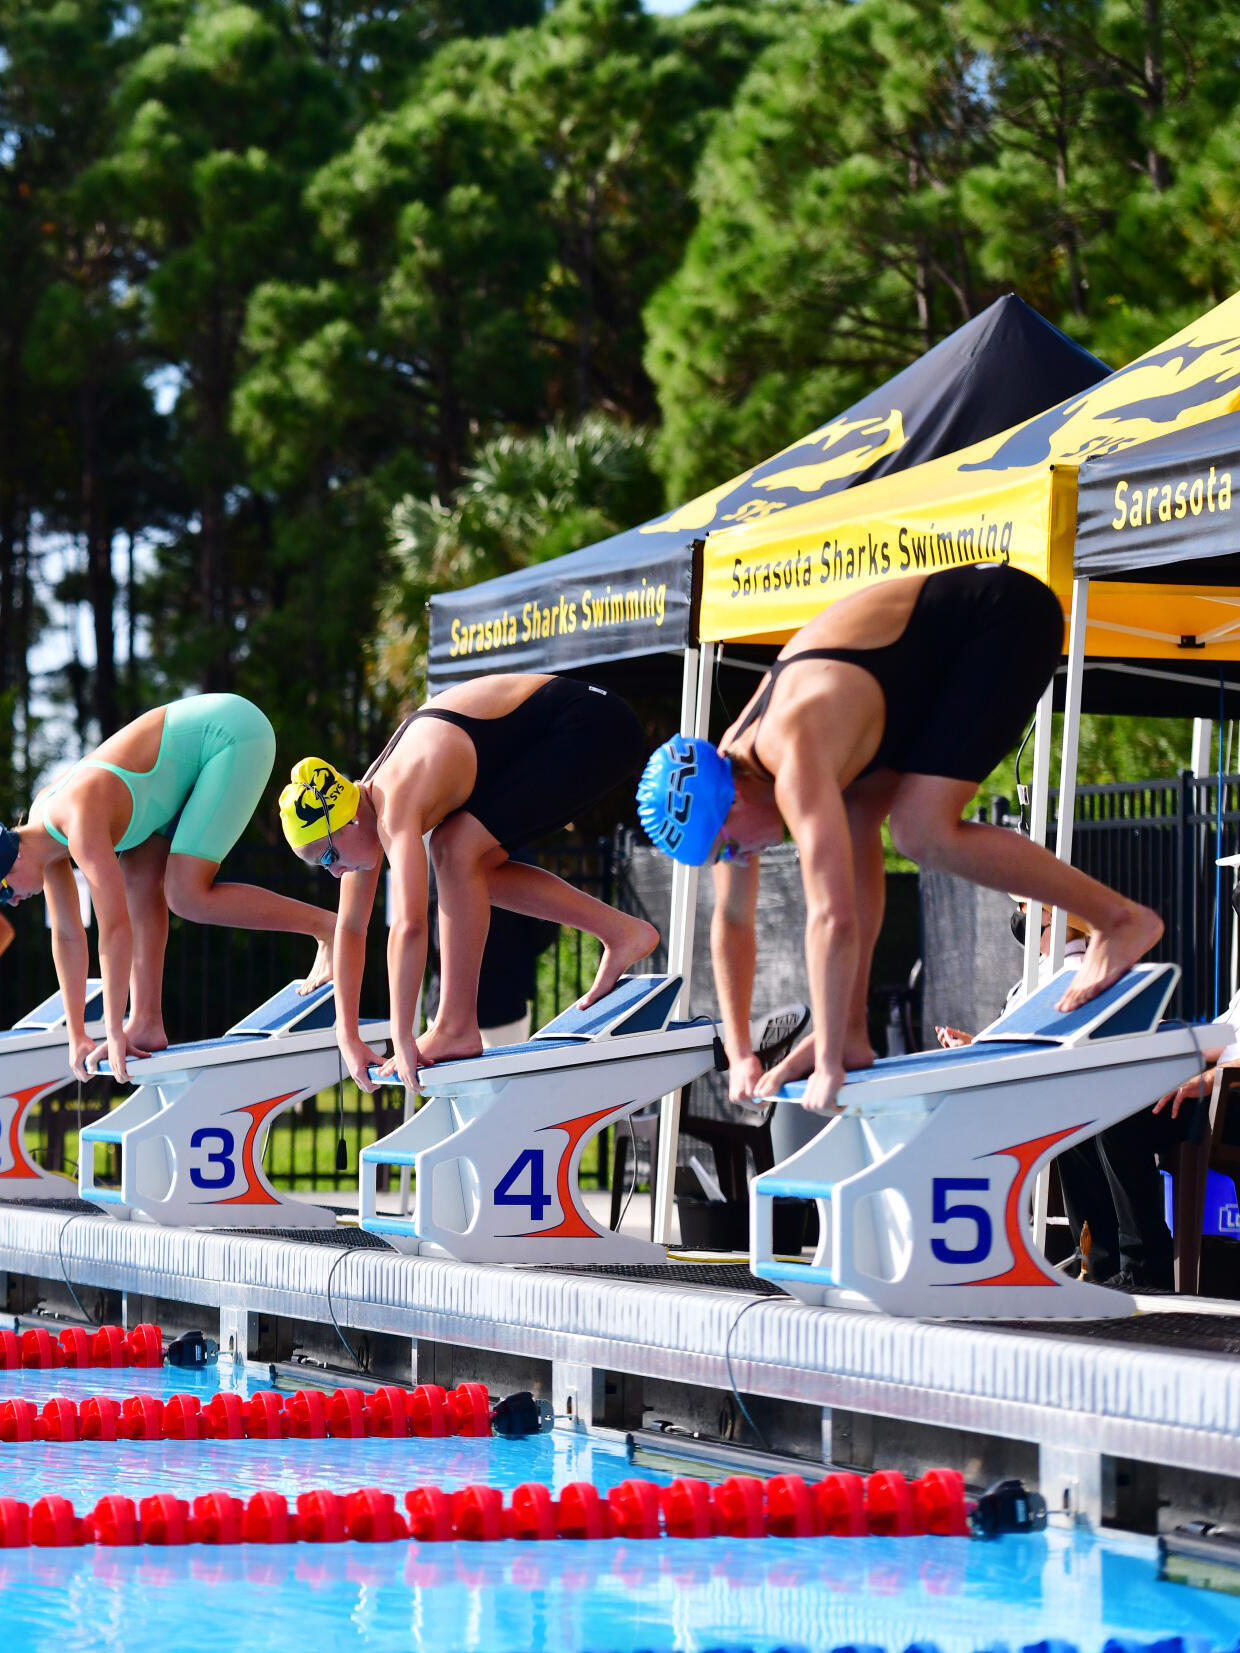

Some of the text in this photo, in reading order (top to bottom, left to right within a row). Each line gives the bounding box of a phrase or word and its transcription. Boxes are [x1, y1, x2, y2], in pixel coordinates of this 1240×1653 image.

[1112, 466, 1232, 530] Sarasota
[730, 513, 1013, 598] Sarasota Sharks Swimming
[449, 577, 667, 657] Sarasota Sharks Swimming
[329, 783, 345, 802] SYS
[189, 1127, 236, 1189] 3
[493, 1149, 552, 1221] 4
[930, 1177, 993, 1265] 5
